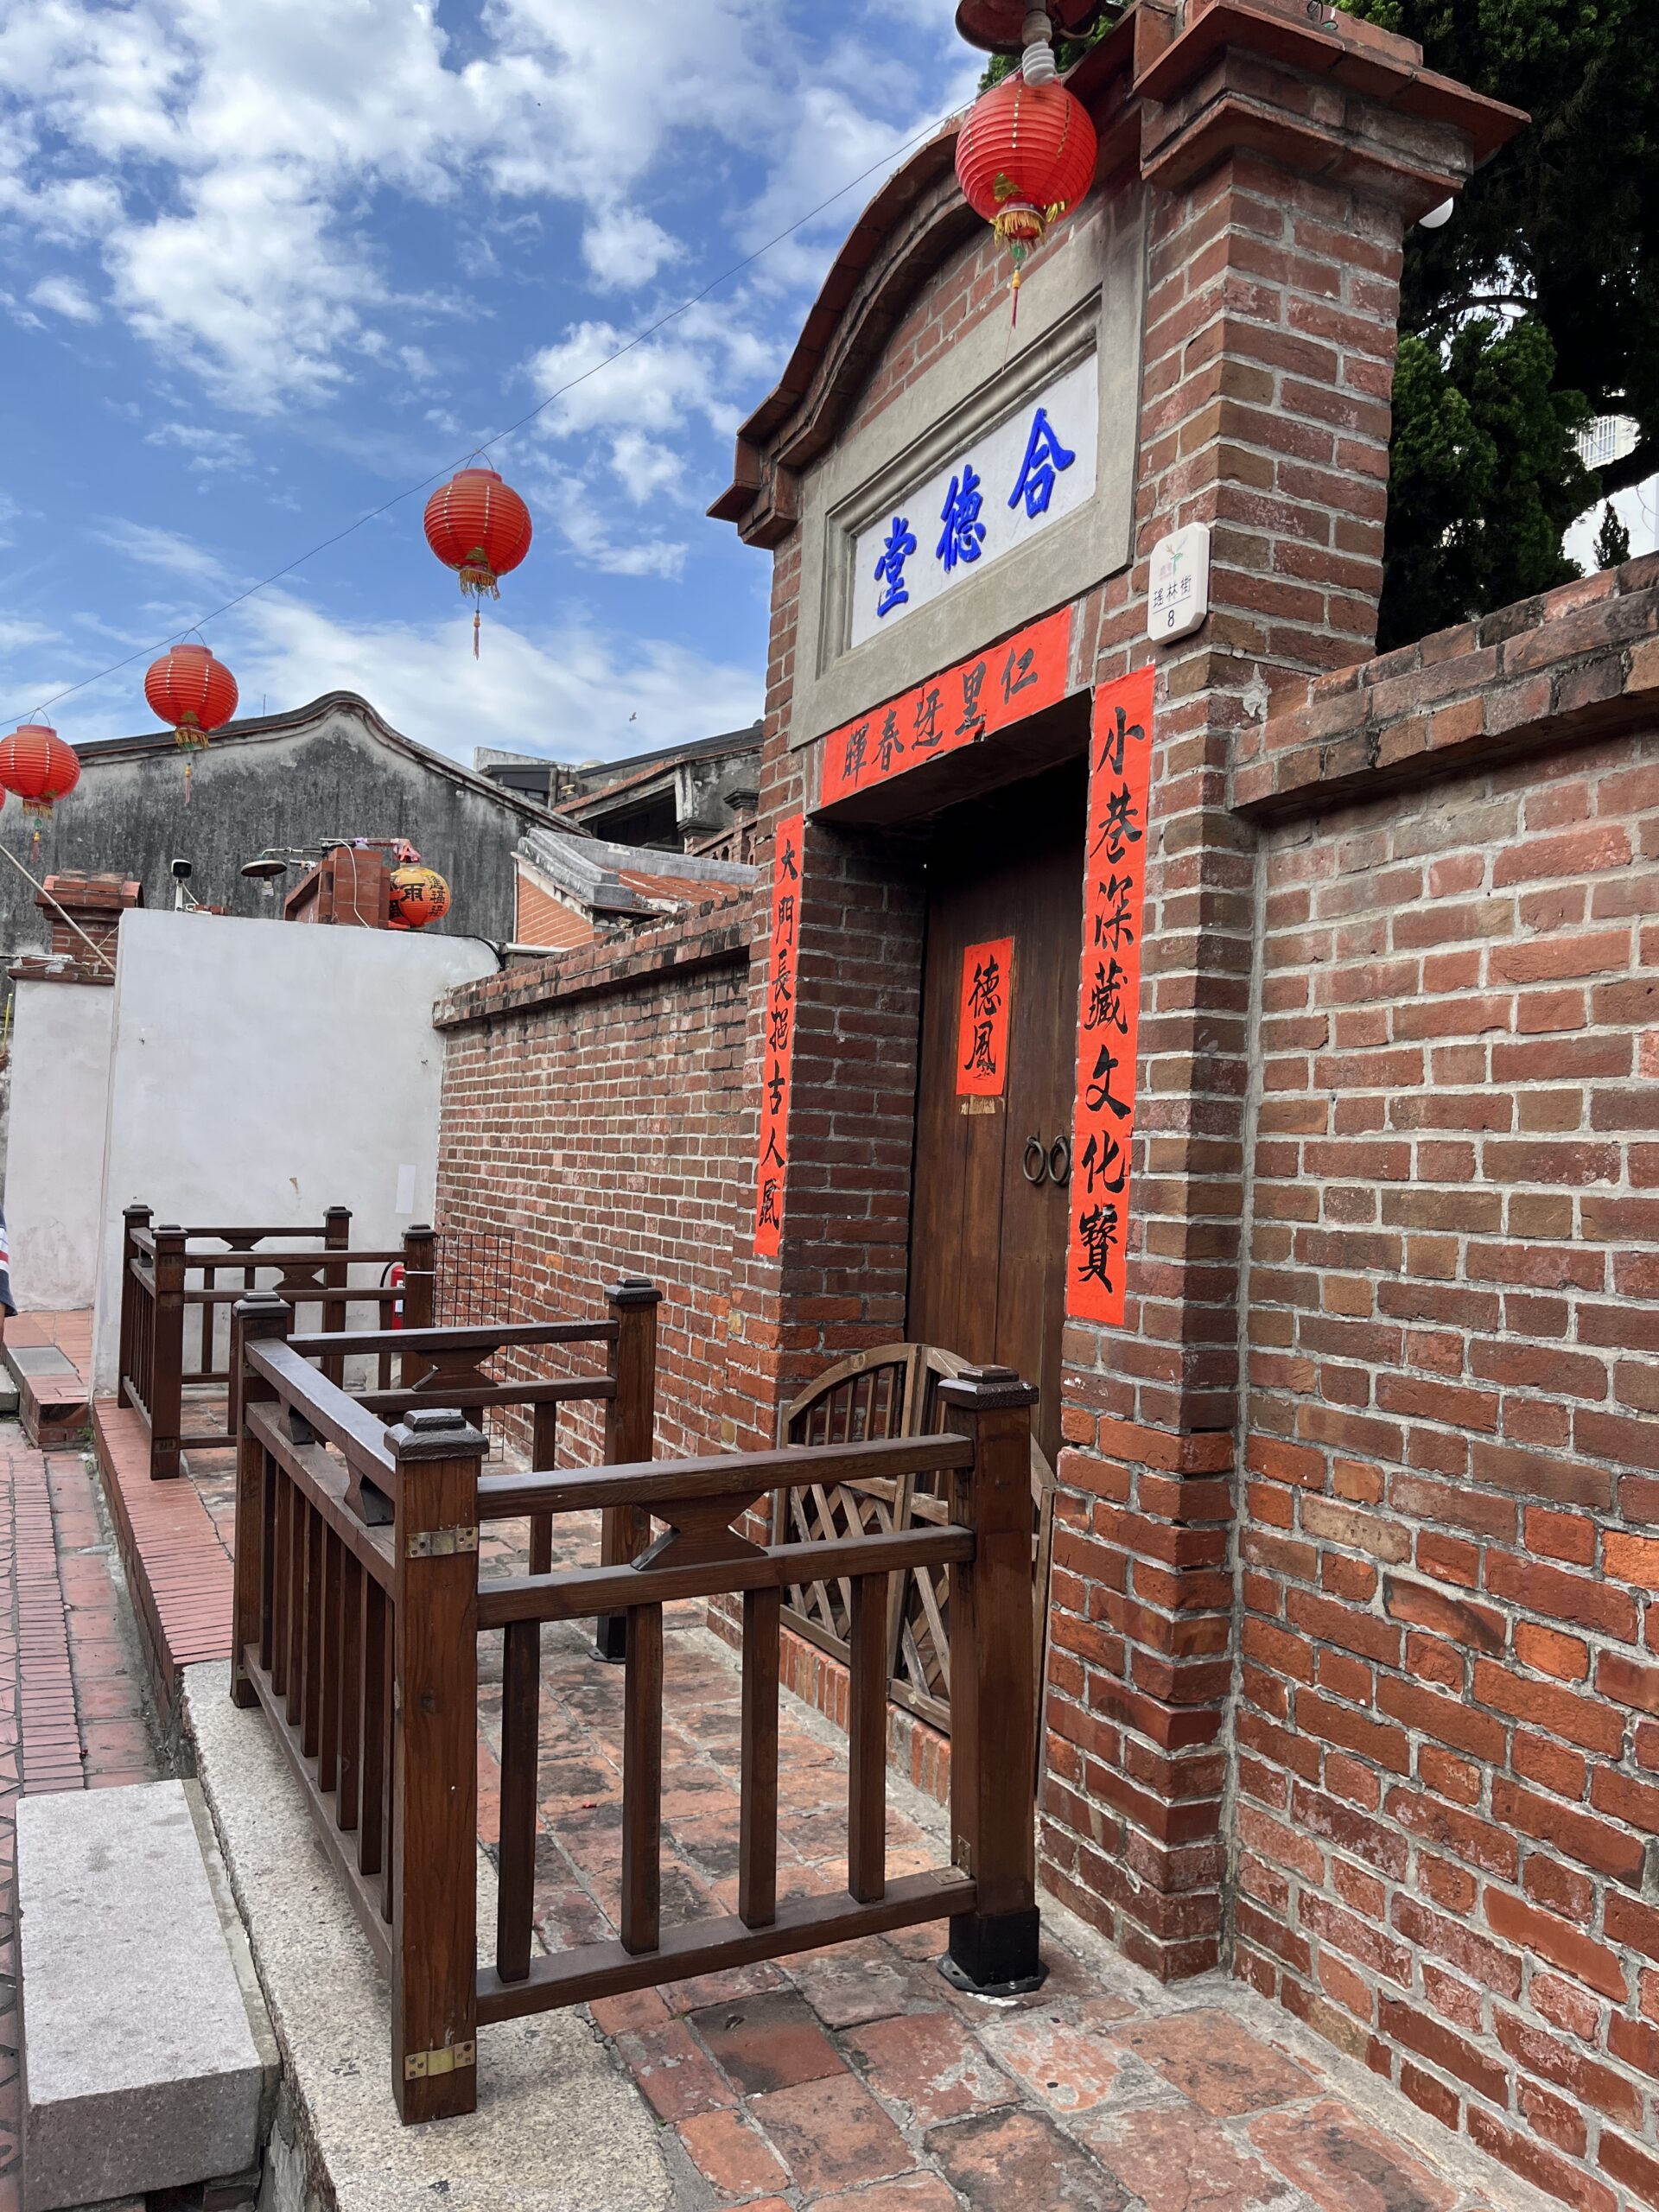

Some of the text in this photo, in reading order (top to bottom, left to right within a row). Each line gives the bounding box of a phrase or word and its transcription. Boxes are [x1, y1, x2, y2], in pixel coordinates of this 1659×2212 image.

[874, 407, 1076, 618] 合德堂
[1167, 609, 1175, 627] 8
[963, 953, 1002, 1077] 德風
